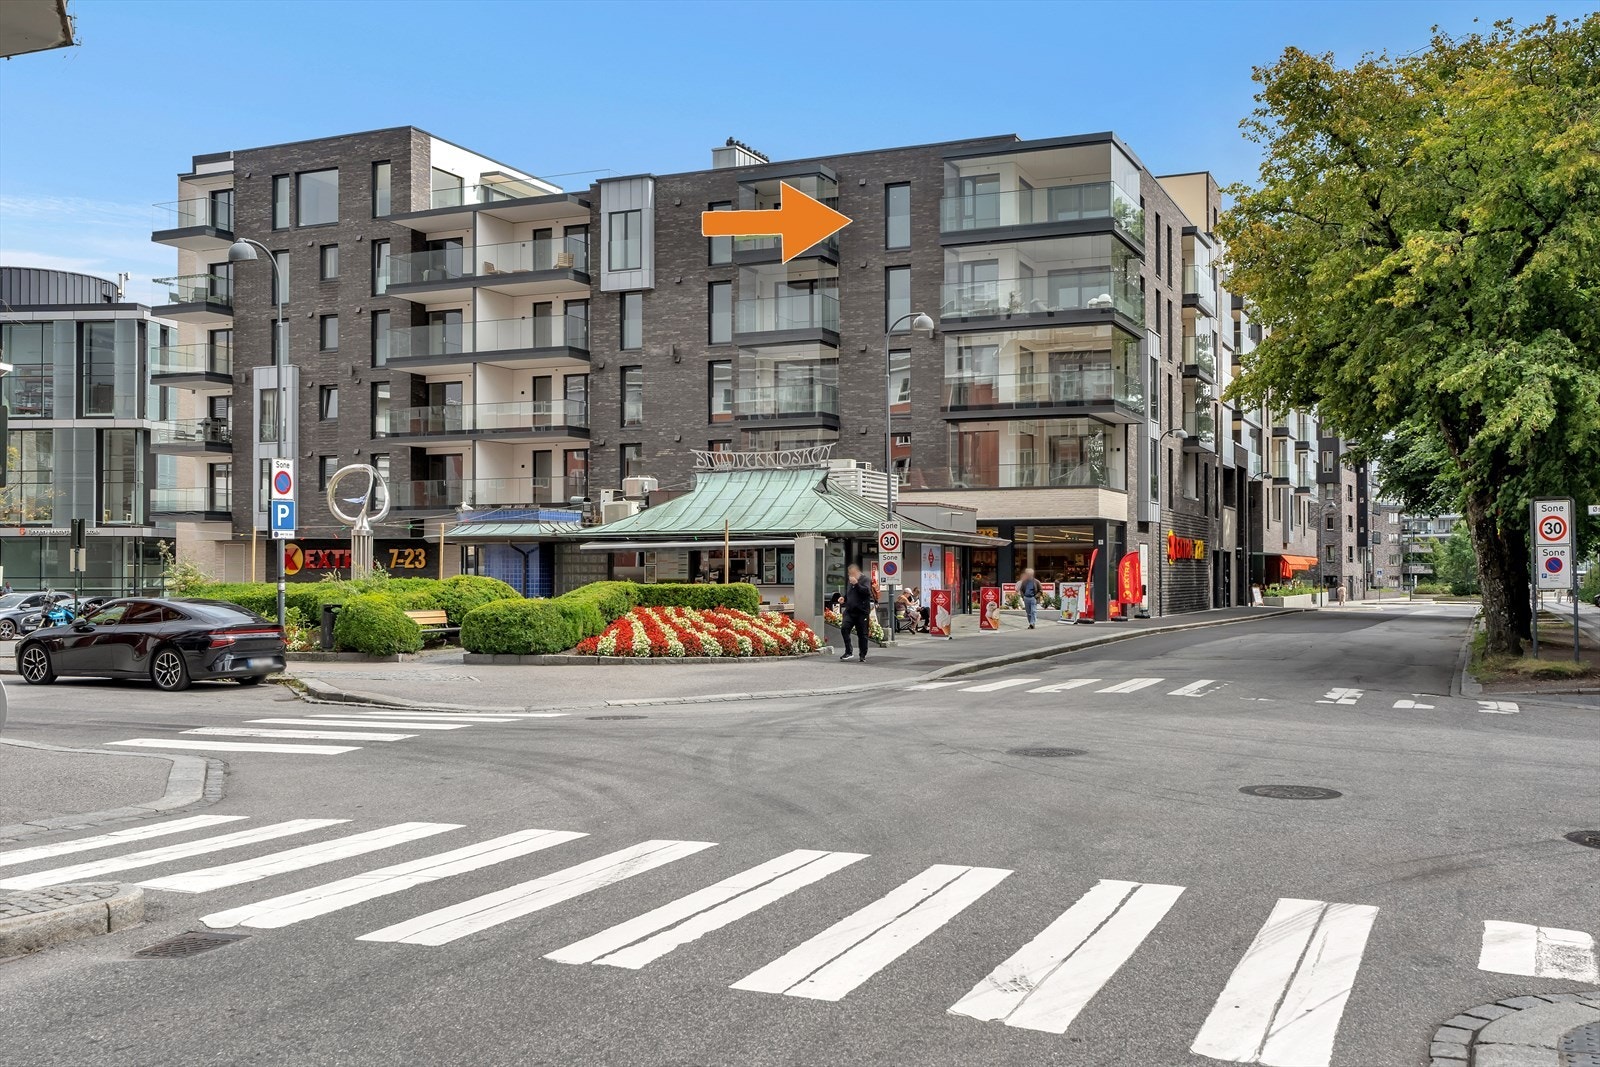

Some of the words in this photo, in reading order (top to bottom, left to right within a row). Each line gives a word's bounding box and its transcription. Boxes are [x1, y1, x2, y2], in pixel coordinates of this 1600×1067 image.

[275, 461, 290, 469] Sone
[1541, 505, 1564, 513] Sone
[277, 504, 290, 527] P
[880, 522, 898, 530] Sone
[1544, 522, 1562, 535] 30
[884, 536, 896, 546] 30
[1542, 548, 1565, 557] Sone
[389, 548, 427, 569] 7-23
[1123, 561, 1131, 589] EXTRA
